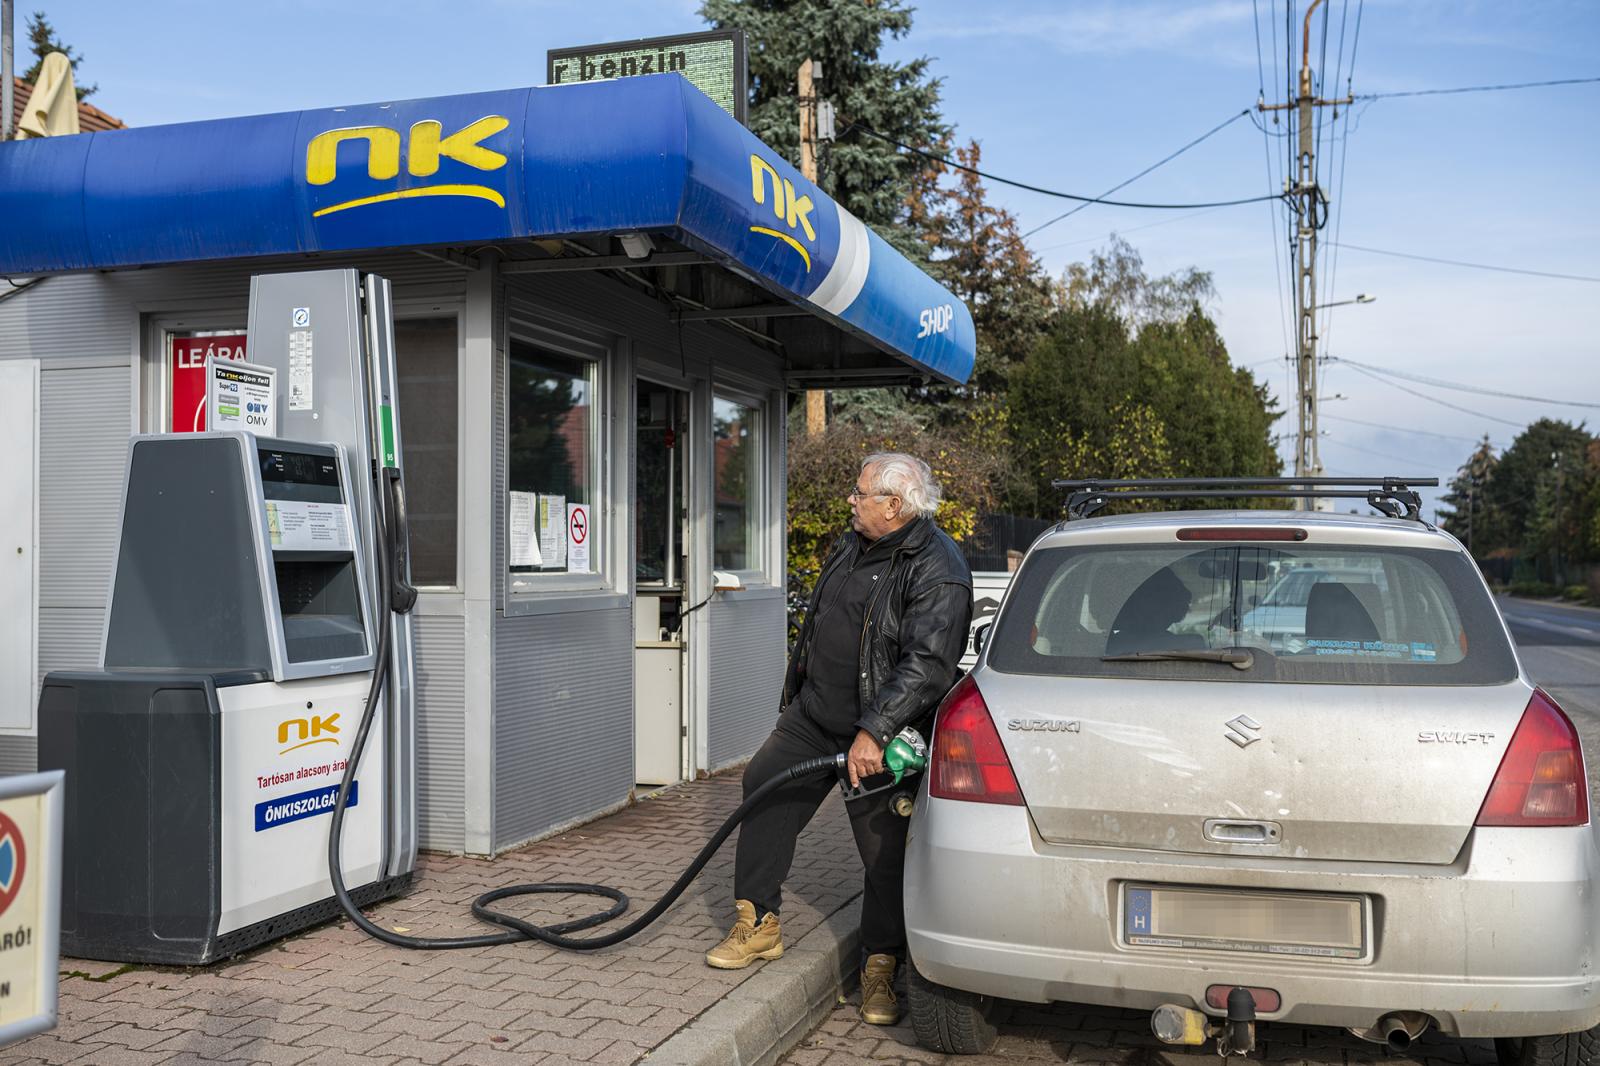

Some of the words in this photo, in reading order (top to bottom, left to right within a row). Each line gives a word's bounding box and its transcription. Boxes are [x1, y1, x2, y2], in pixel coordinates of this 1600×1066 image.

[580, 48, 686, 81] benzin
[917, 304, 954, 339] SHOP
[247, 415, 267, 426] OMV
[1008, 719, 1080, 733] SUZUKI
[1418, 732, 1495, 745] SWIFT
[257, 772, 294, 789] Tartósan
[296, 764, 331, 780] alacsony
[265, 789, 350, 823] ÖNKISZOLGÁ
[1135, 915, 1146, 929] H
[0, 925, 31, 952] RÓ!
